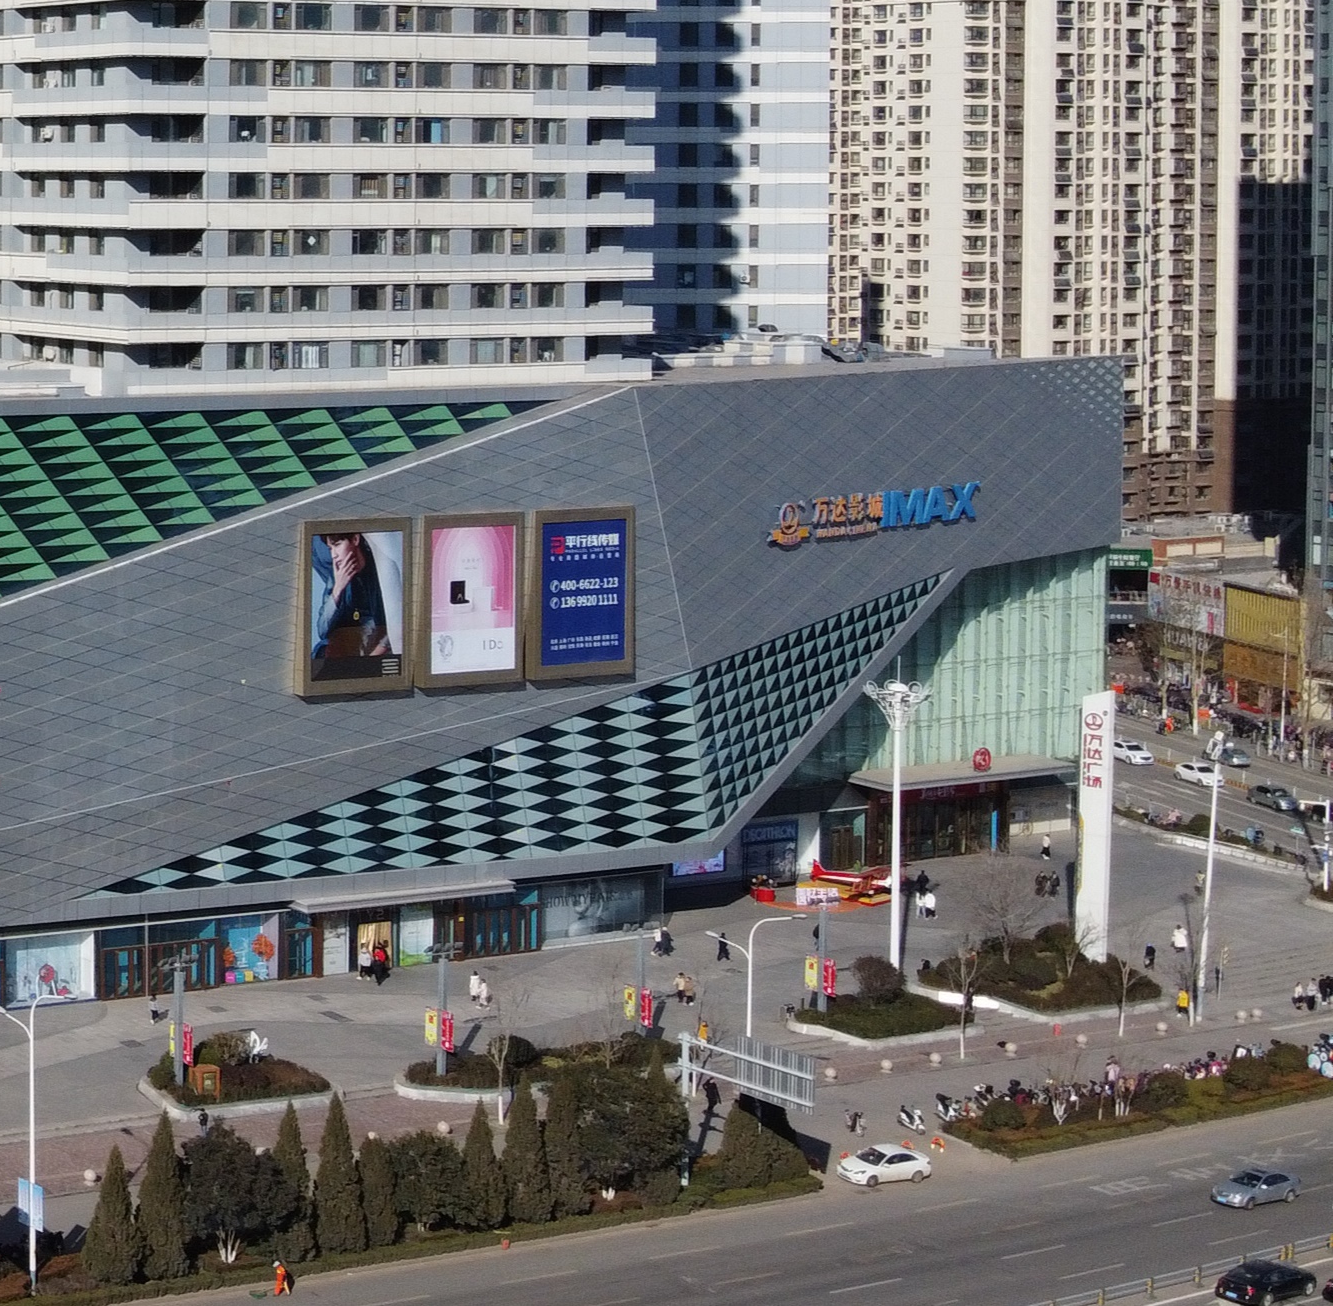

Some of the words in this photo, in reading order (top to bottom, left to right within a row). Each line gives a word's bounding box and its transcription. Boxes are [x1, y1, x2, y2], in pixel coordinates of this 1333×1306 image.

[812, 492, 883, 525] 万达影城
[880, 481, 981, 527] IMAX
[561, 577, 619, 591] 400-6622-123
[1086, 733, 1103, 789] 万达广场
[742, 824, 797, 842] DECATHLON
